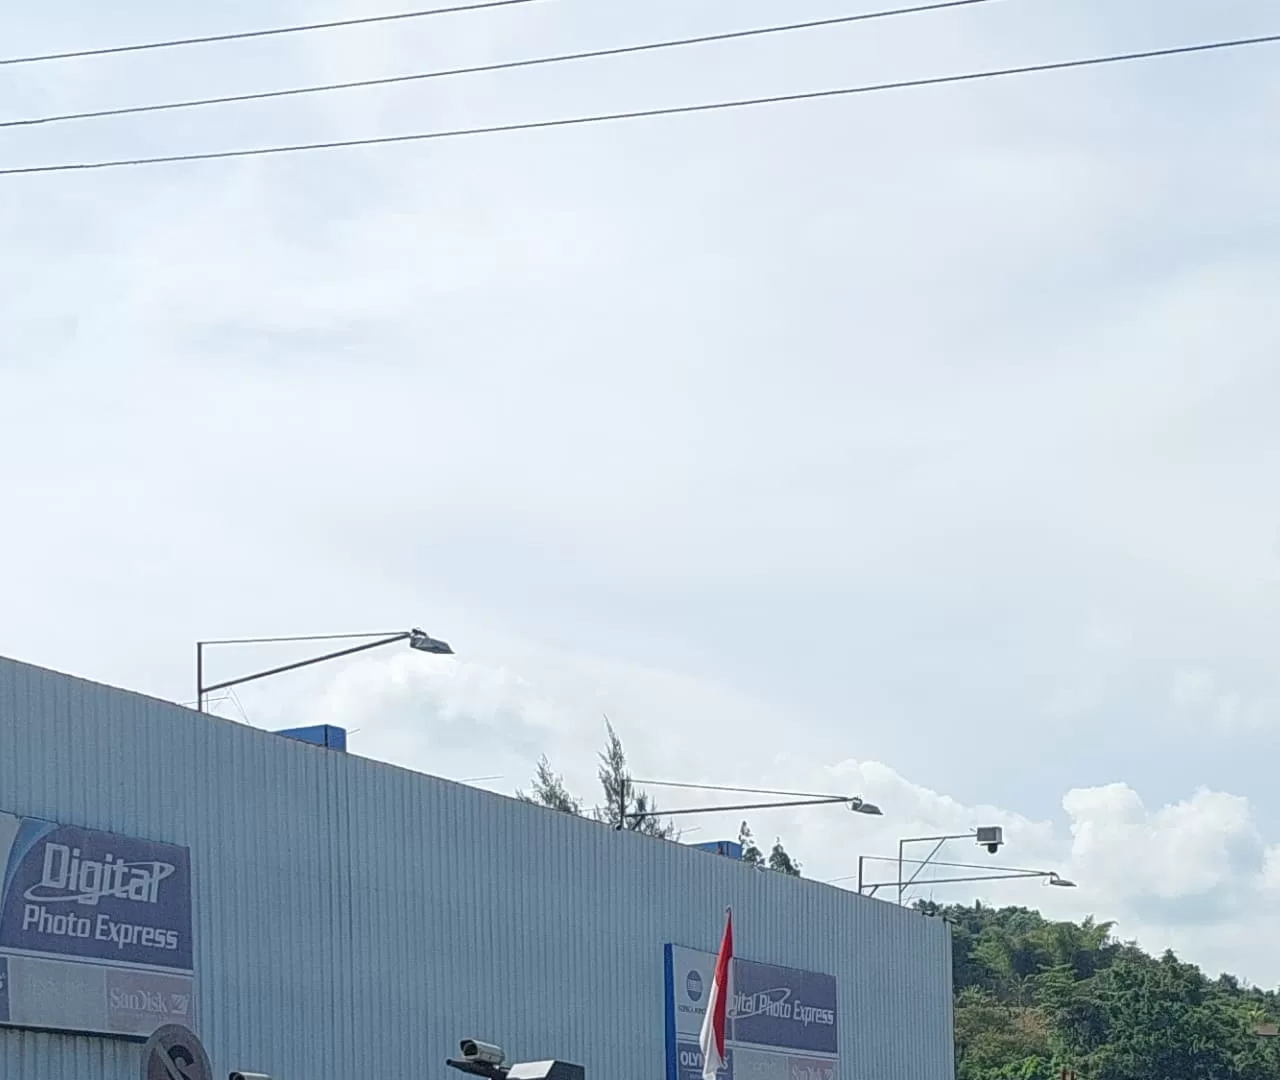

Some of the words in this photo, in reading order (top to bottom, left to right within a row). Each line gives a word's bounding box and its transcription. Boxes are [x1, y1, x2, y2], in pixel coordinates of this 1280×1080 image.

[38, 842, 165, 904] Digital
[22, 903, 91, 939] Photo
[95, 914, 180, 950] Express
[109, 987, 168, 1014] SanDisk
[759, 994, 792, 1018] Photo
[793, 1000, 835, 1027] Express
